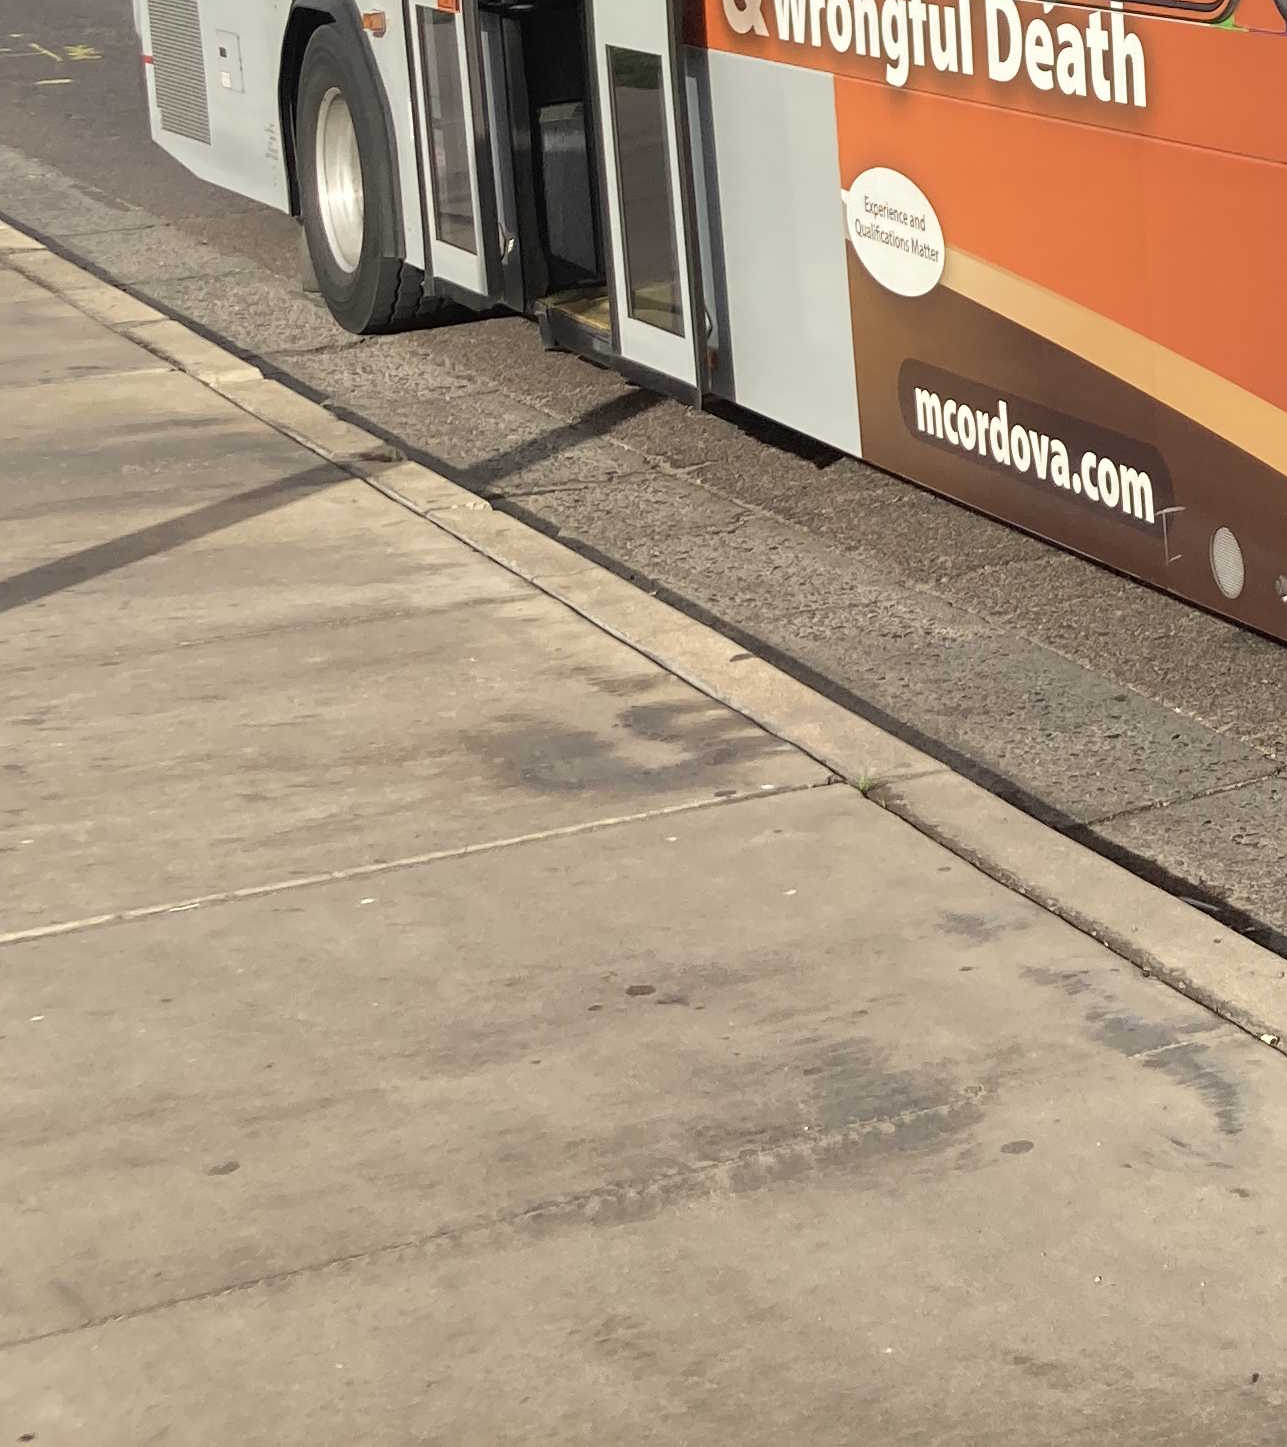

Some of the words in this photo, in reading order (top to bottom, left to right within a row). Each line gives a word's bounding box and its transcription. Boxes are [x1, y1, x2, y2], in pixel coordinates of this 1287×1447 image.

[864, 195, 908, 226] Experience
[909, 213, 926, 232] and
[854, 217, 910, 253] Qualifications
[911, 237, 939, 263] Matter
[914, 385, 1155, 524] mcordova.com
